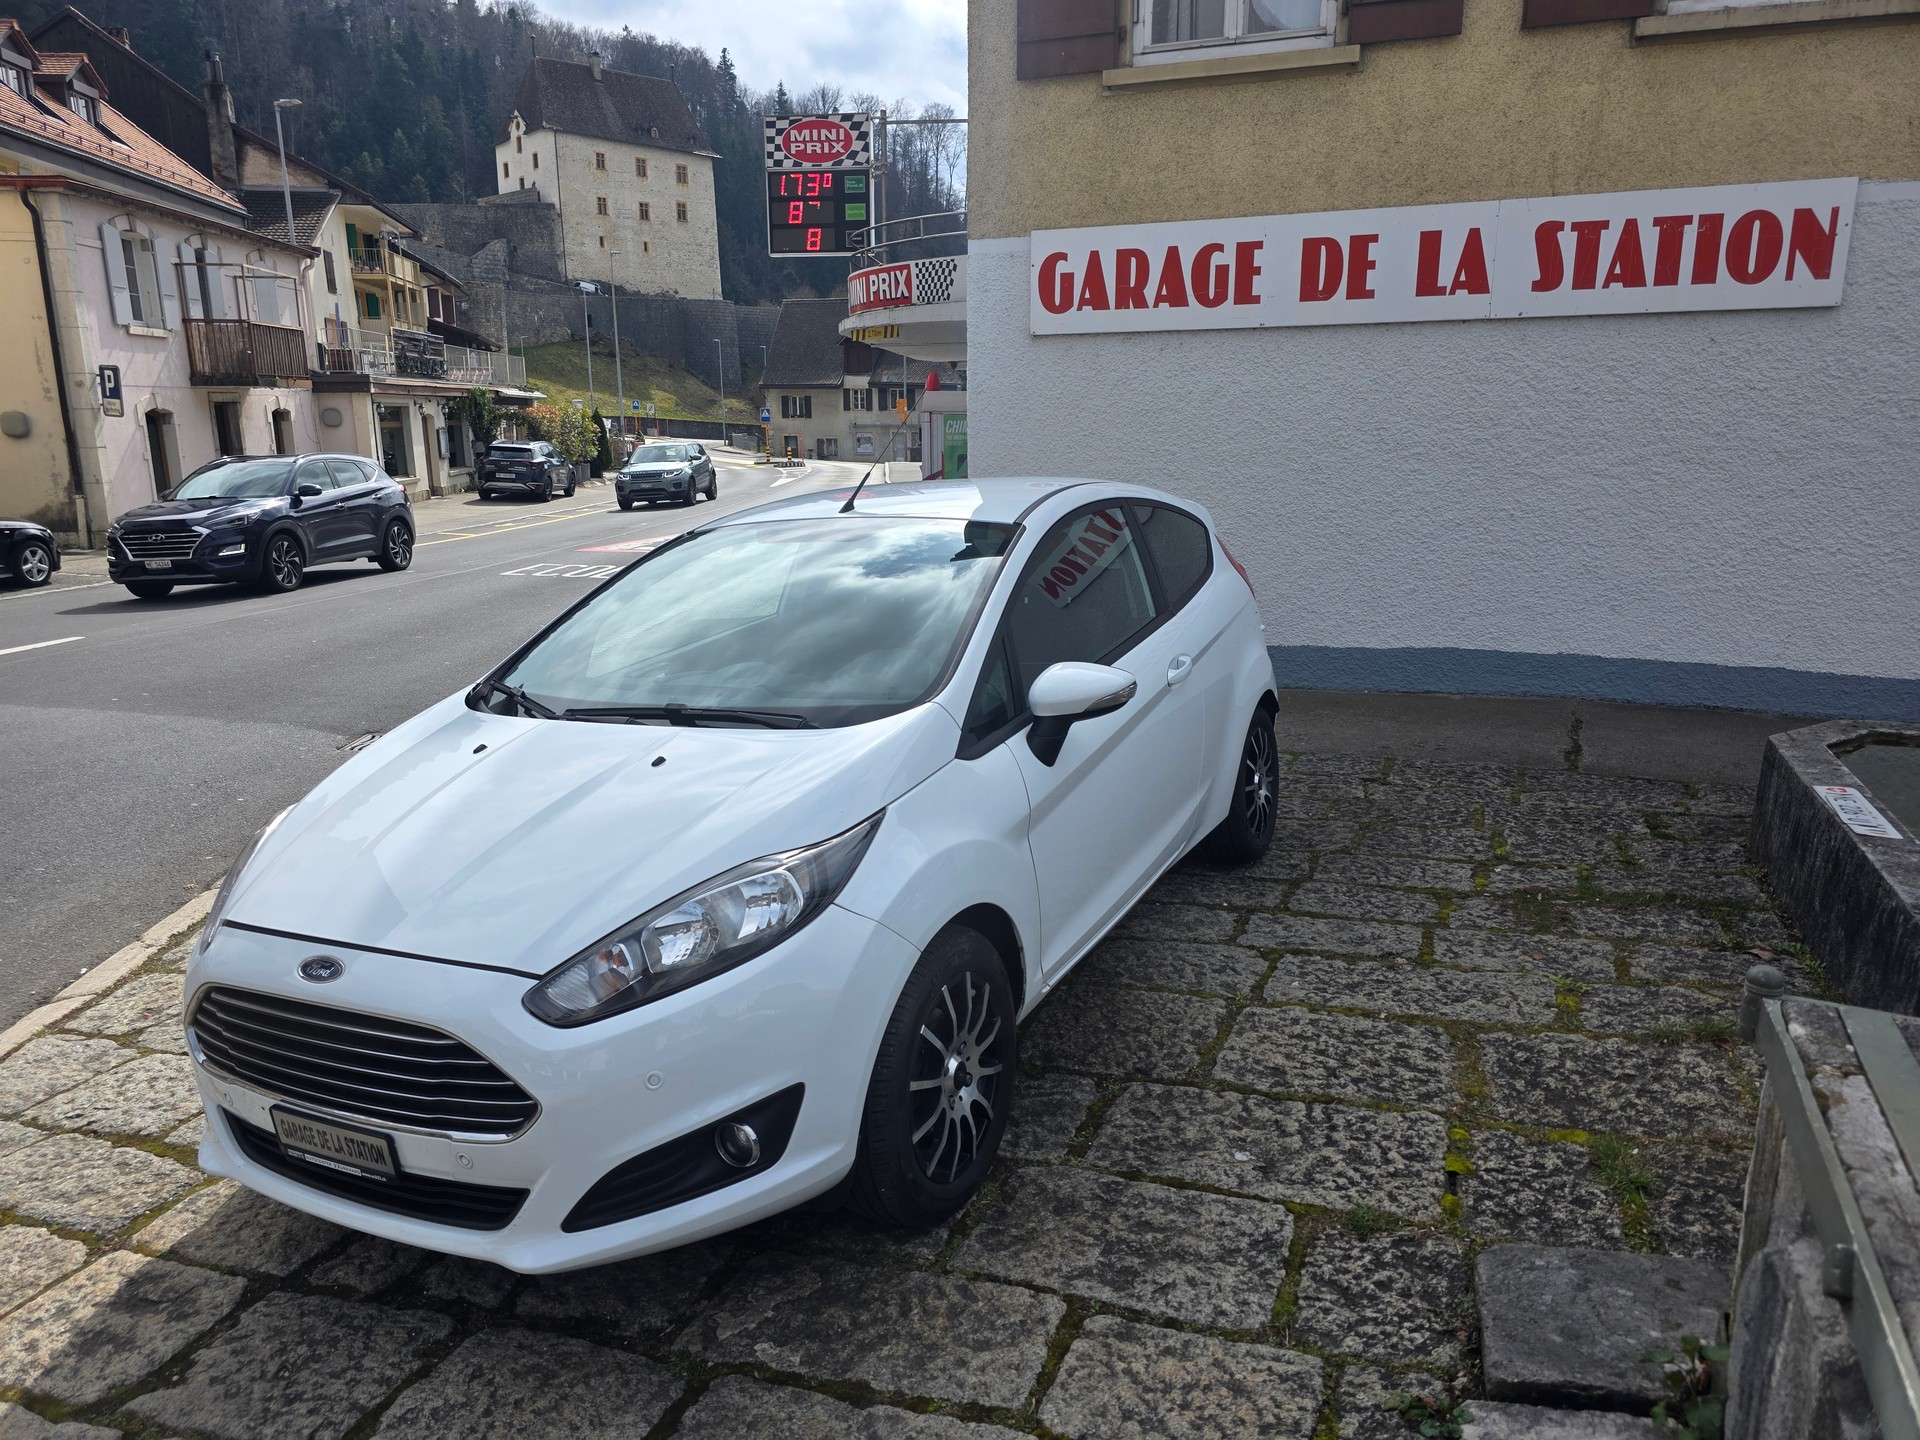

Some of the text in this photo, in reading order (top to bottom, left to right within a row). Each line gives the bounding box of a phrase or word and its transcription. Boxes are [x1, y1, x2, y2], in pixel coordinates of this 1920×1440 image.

[789, 128, 845, 141] MINI
[790, 141, 846, 154] PRIX
[1038, 206, 1840, 315] GARAGE DE LA STATION
[850, 269, 910, 307] MINI PRIX
[104, 370, 115, 397] P
[307, 961, 334, 977] Ford
[281, 1119, 318, 1147] GARAGE
[316, 1130, 331, 1150] DE
[330, 1132, 346, 1155] LA
[344, 1136, 387, 1166] STATION
